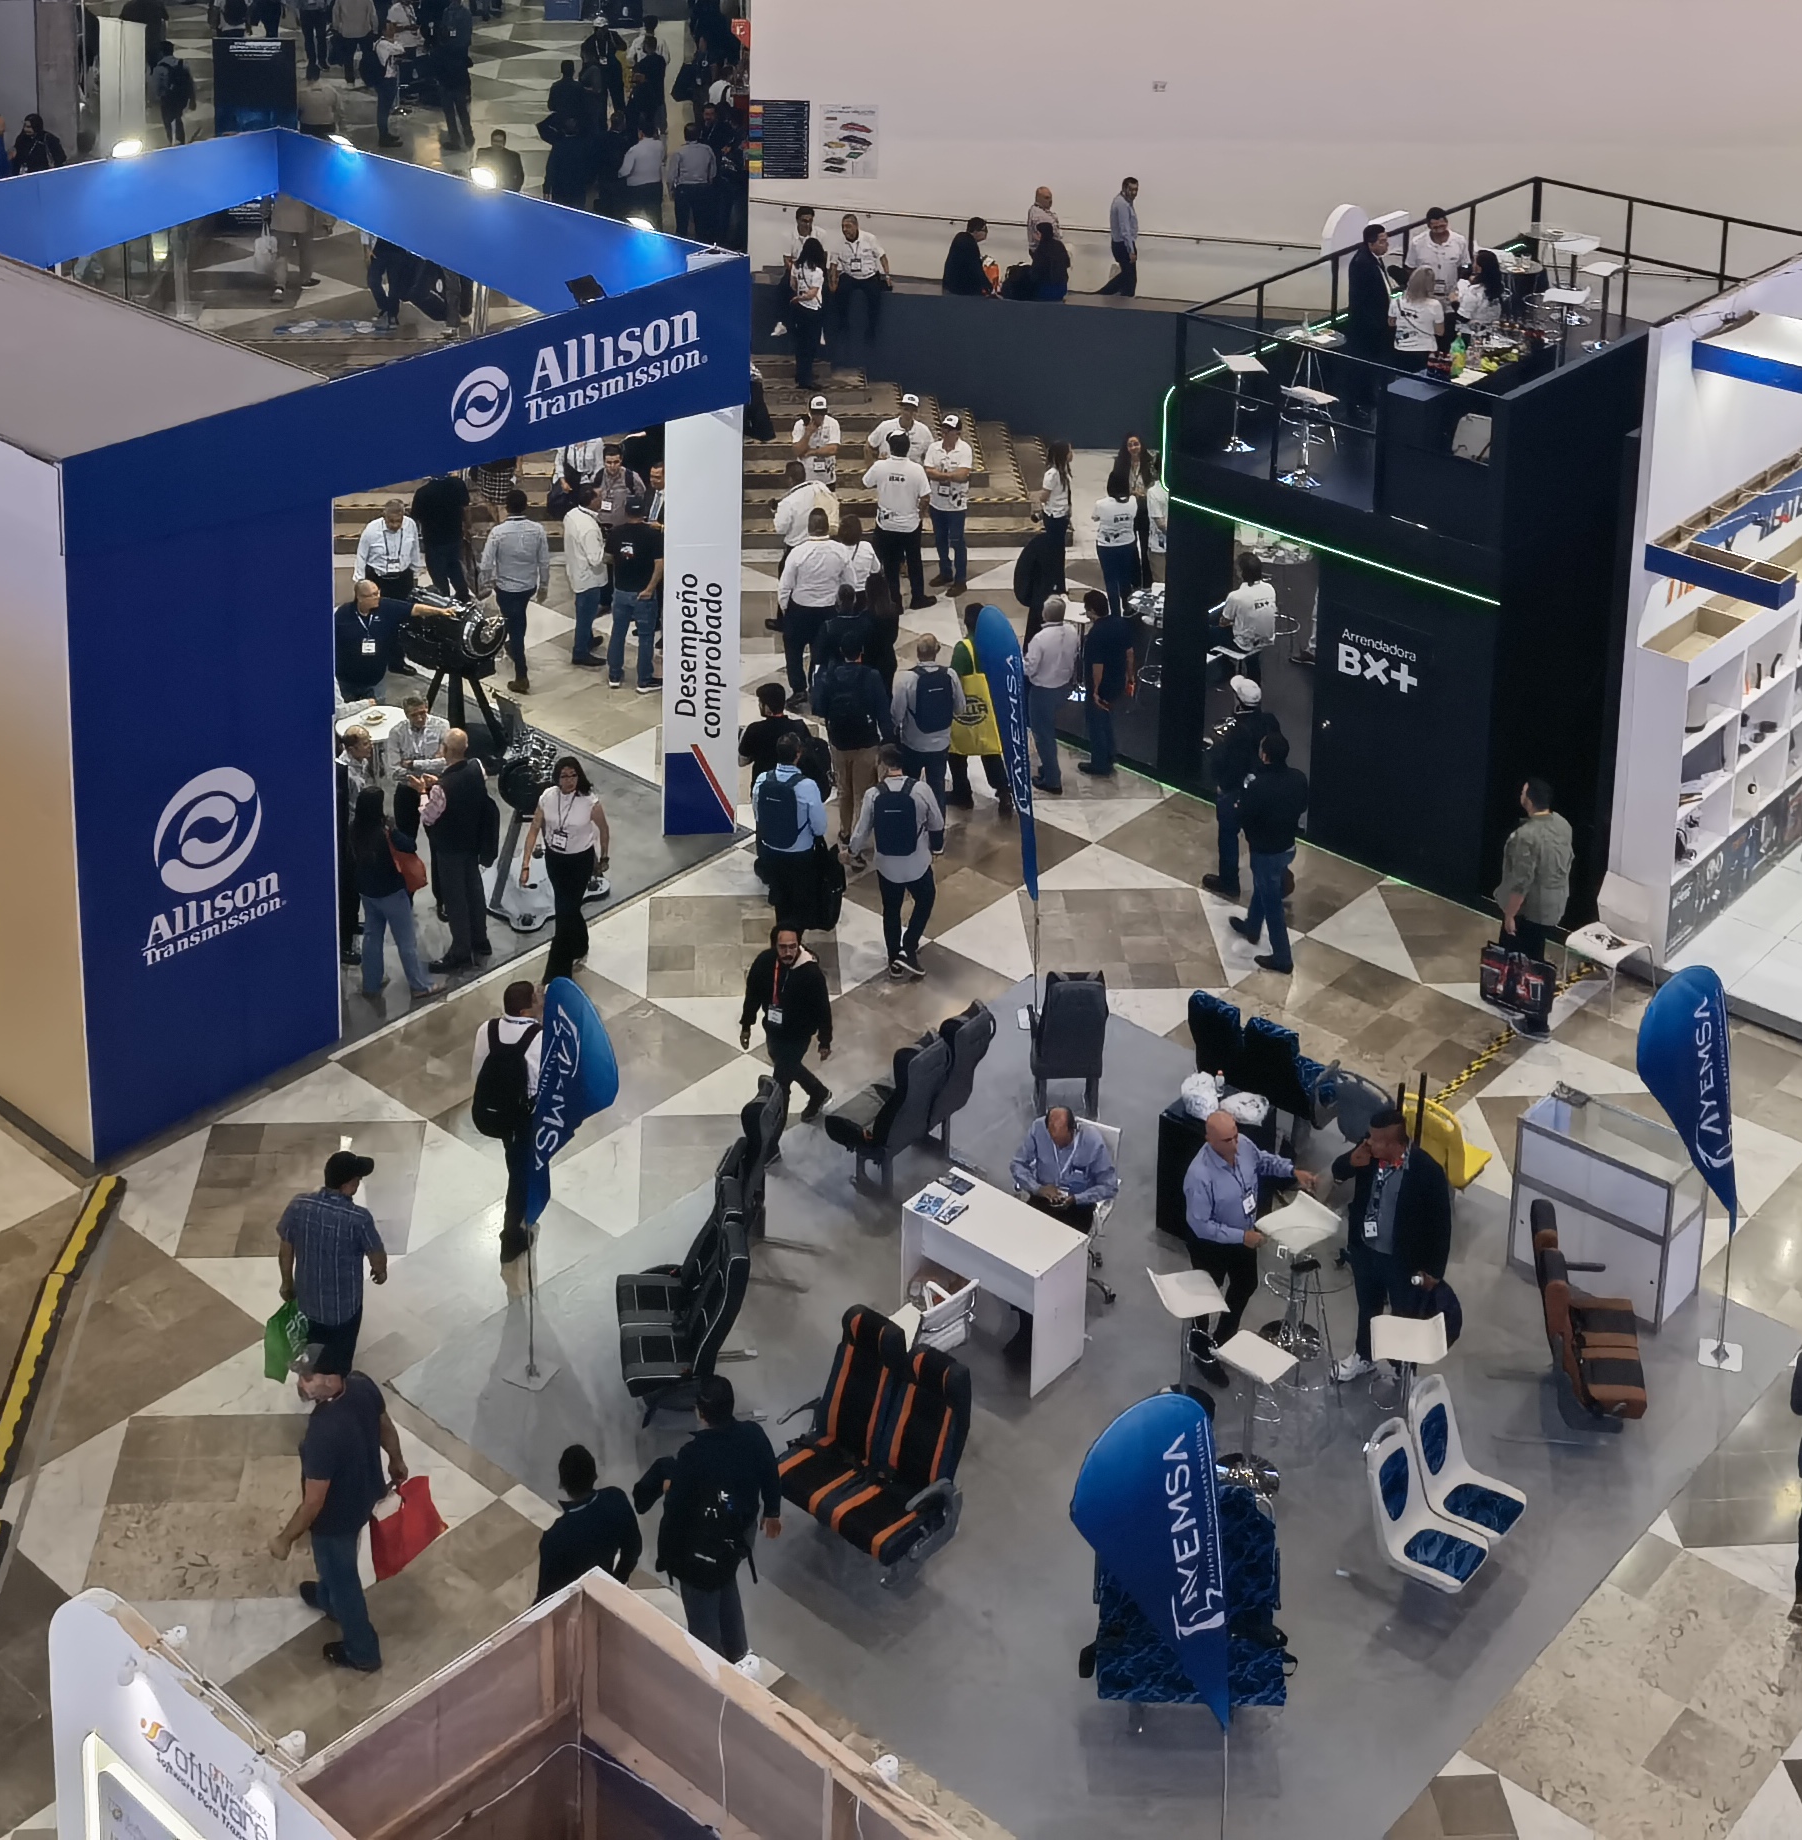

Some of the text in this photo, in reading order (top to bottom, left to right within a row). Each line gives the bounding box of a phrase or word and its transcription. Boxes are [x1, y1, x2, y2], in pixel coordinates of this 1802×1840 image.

[524, 349, 703, 427] Transmission
[526, 308, 701, 398] Allison
[674, 571, 700, 719] Desempeño
[704, 581, 724, 739] comprobado
[1337, 642, 1419, 695] BX+
[1340, 627, 1418, 662] Arrendadora
[142, 895, 283, 967] Transmission
[144, 869, 281, 950] Allison
